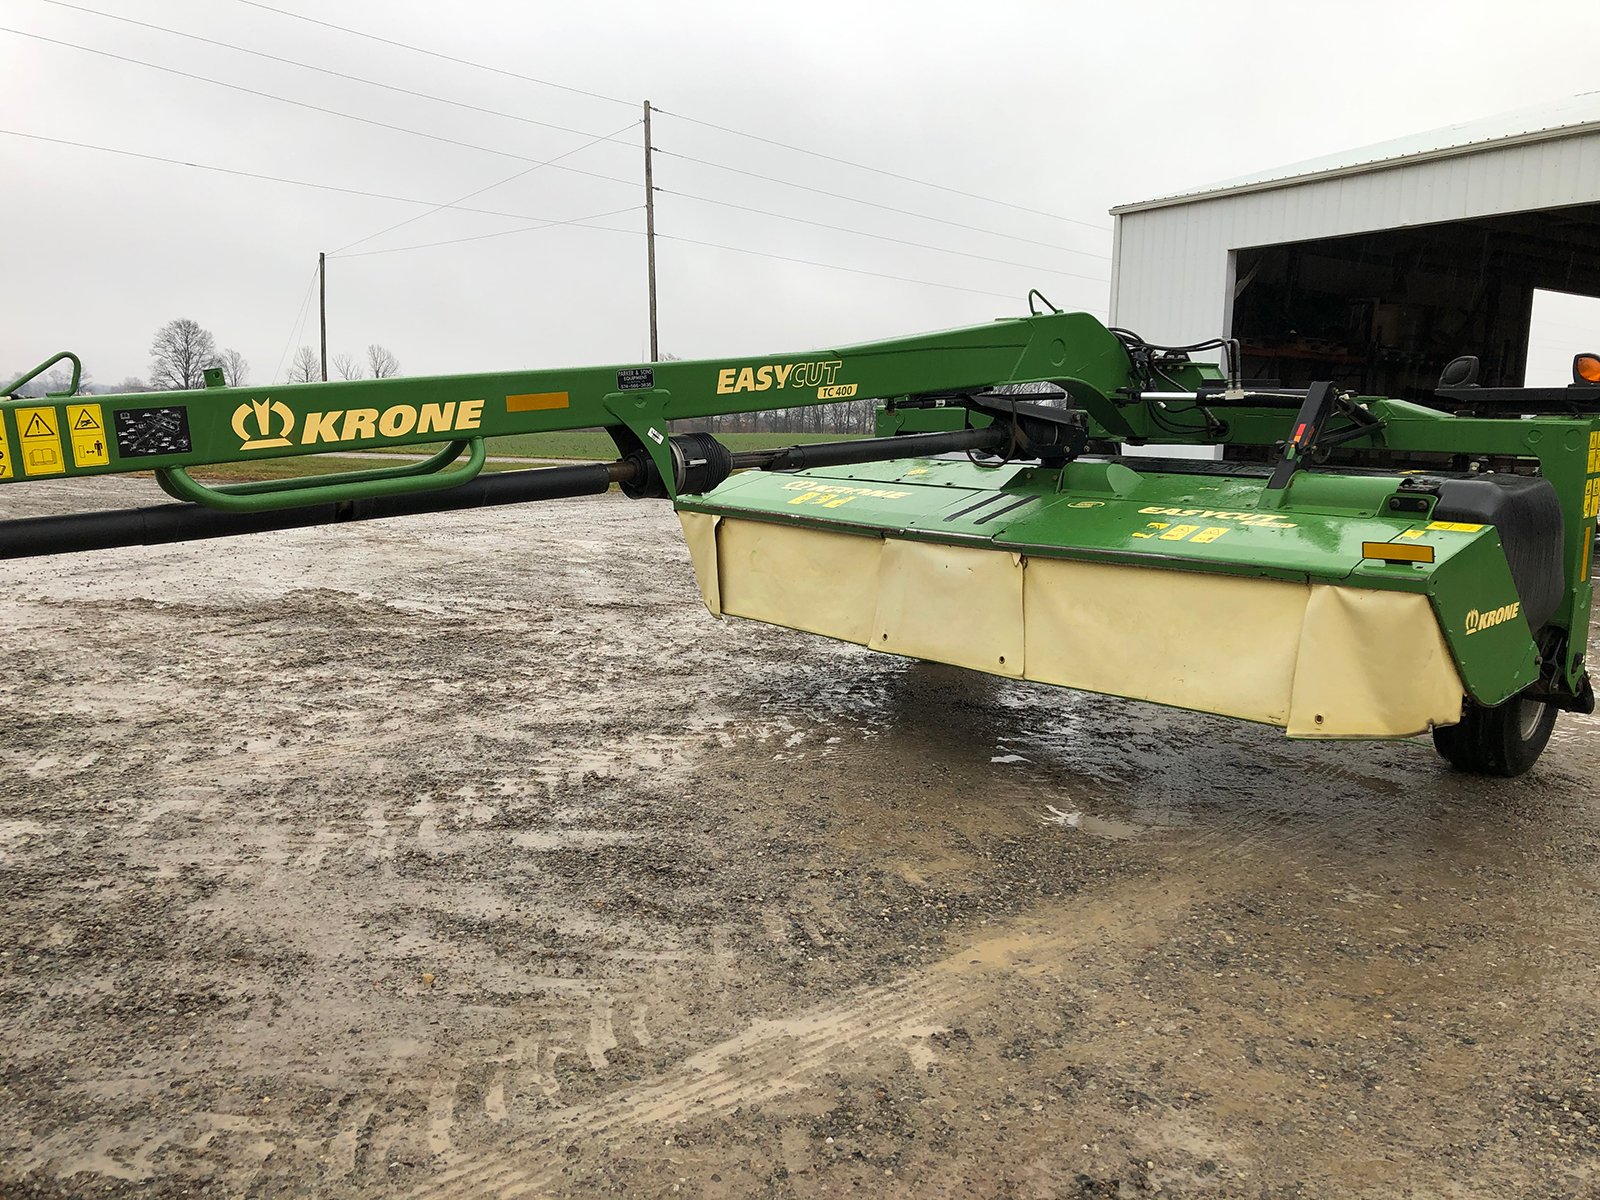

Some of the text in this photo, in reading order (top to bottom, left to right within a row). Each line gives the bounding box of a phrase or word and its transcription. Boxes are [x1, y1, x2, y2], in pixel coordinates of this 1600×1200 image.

[717, 361, 842, 394] EASYCUT
[822, 386, 852, 397] TC 400
[301, 400, 485, 444] KRONE
[1138, 507, 1290, 523] EASYCUT
[1478, 602, 1520, 631] KRONE
